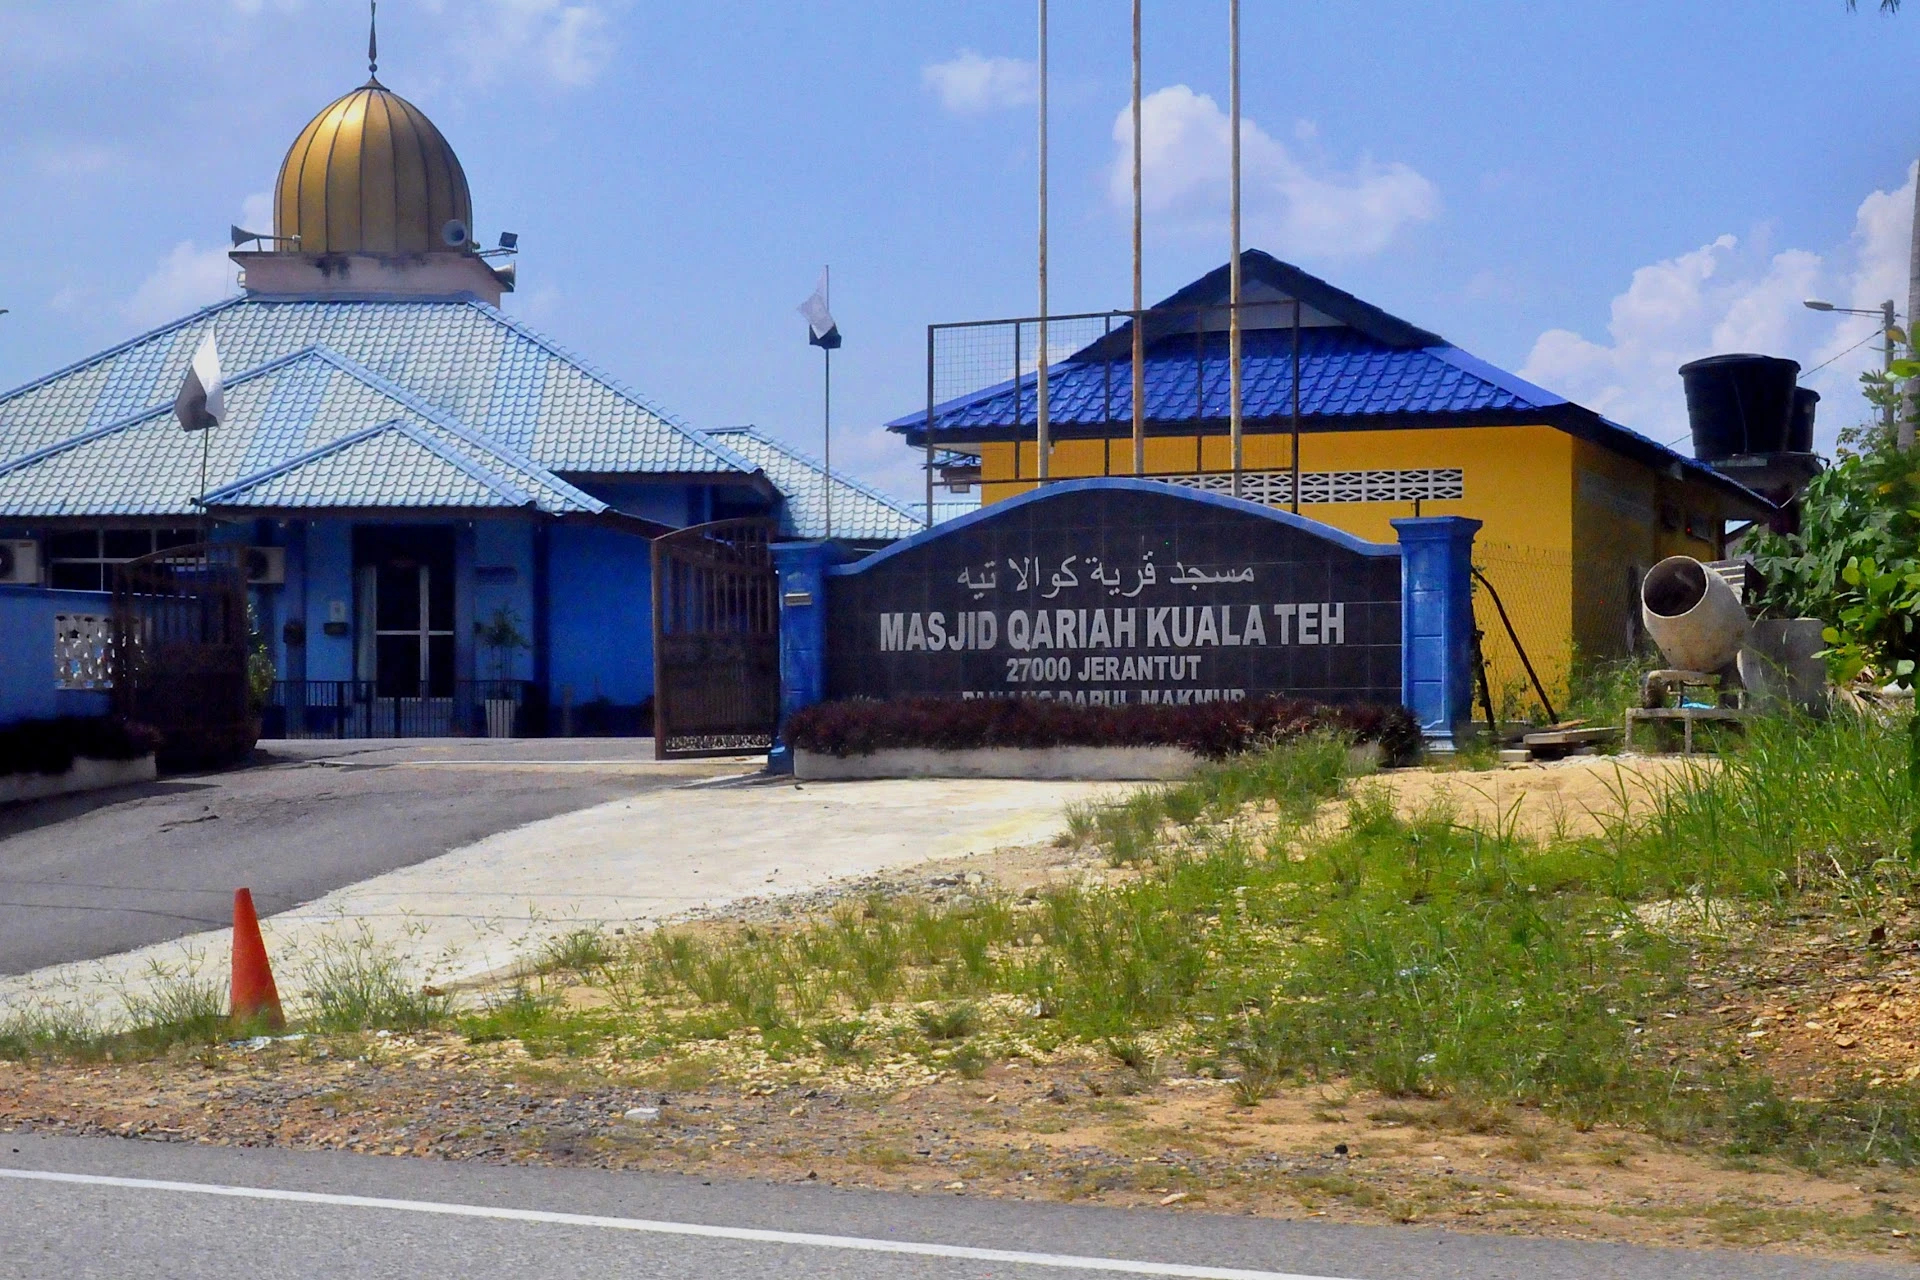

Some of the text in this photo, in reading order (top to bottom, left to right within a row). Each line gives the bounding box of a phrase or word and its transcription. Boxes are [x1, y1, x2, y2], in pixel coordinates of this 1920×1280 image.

[1084, 551, 1157, 598] قرية
[1170, 562, 1255, 592] مسجد
[880, 603, 1345, 652] MASJID QARIAH KUALA TEH
[1006, 655, 1201, 682] 27000 JERANTUT
